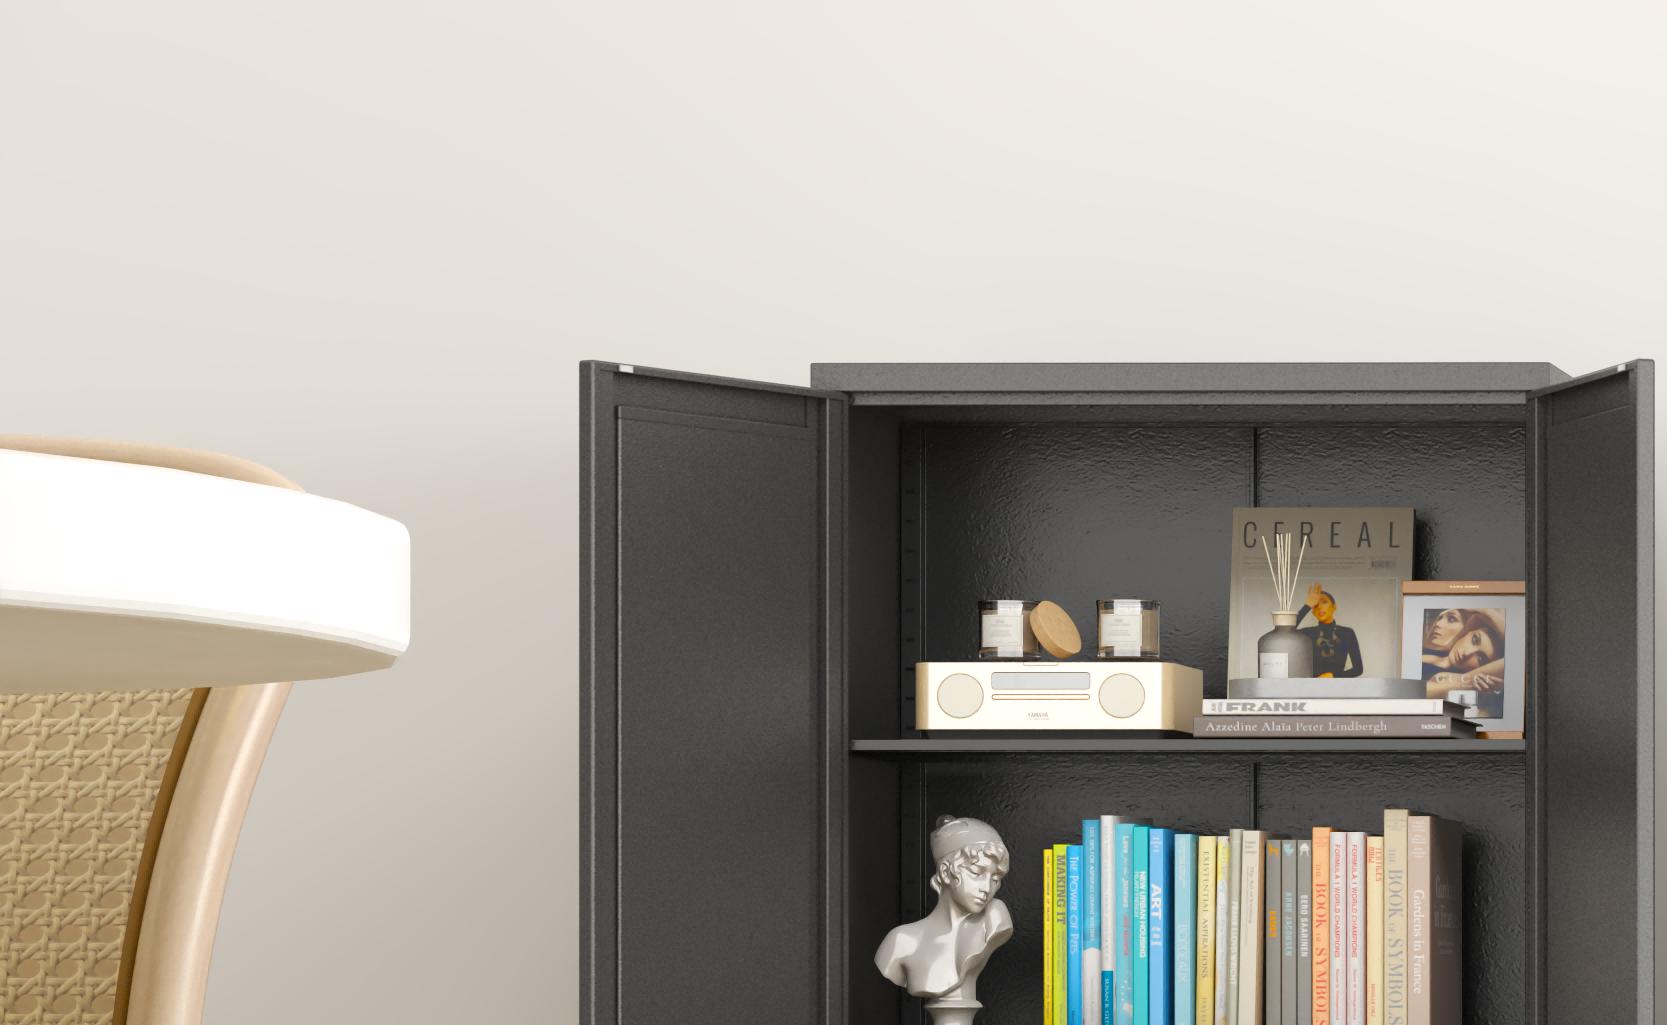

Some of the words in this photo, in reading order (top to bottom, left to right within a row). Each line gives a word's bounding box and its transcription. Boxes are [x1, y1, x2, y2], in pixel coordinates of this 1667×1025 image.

[1243, 521, 1400, 548] CEREAL
[1226, 702, 1307, 712] FRANK
[1205, 720, 1257, 732] Azzedine
[1296, 720, 1324, 732] Peter
[1328, 720, 1387, 734] Lindbergh
[1056, 855, 1066, 908] MAKING
[1201, 851, 1210, 912] EXISTENTIAL
[1388, 870, 1403, 918] BOOK
[1056, 911, 1066, 925] IT
[1151, 883, 1162, 921] ART
[1285, 891, 1293, 913] ARNE
[1300, 894, 1308, 915] EERO
[1315, 883, 1328, 928] BOOK
[1413, 889, 1425, 937] Gardens
[1139, 921, 1147, 958] HOUSING
[1200, 918, 1208, 979] ASPIRATIONS
[1285, 916, 1293, 957] JACOBSEN
[1300, 917, 1308, 957] SAARINEN
[1413, 940, 1425, 952] in
[1413, 955, 1425, 994] France
